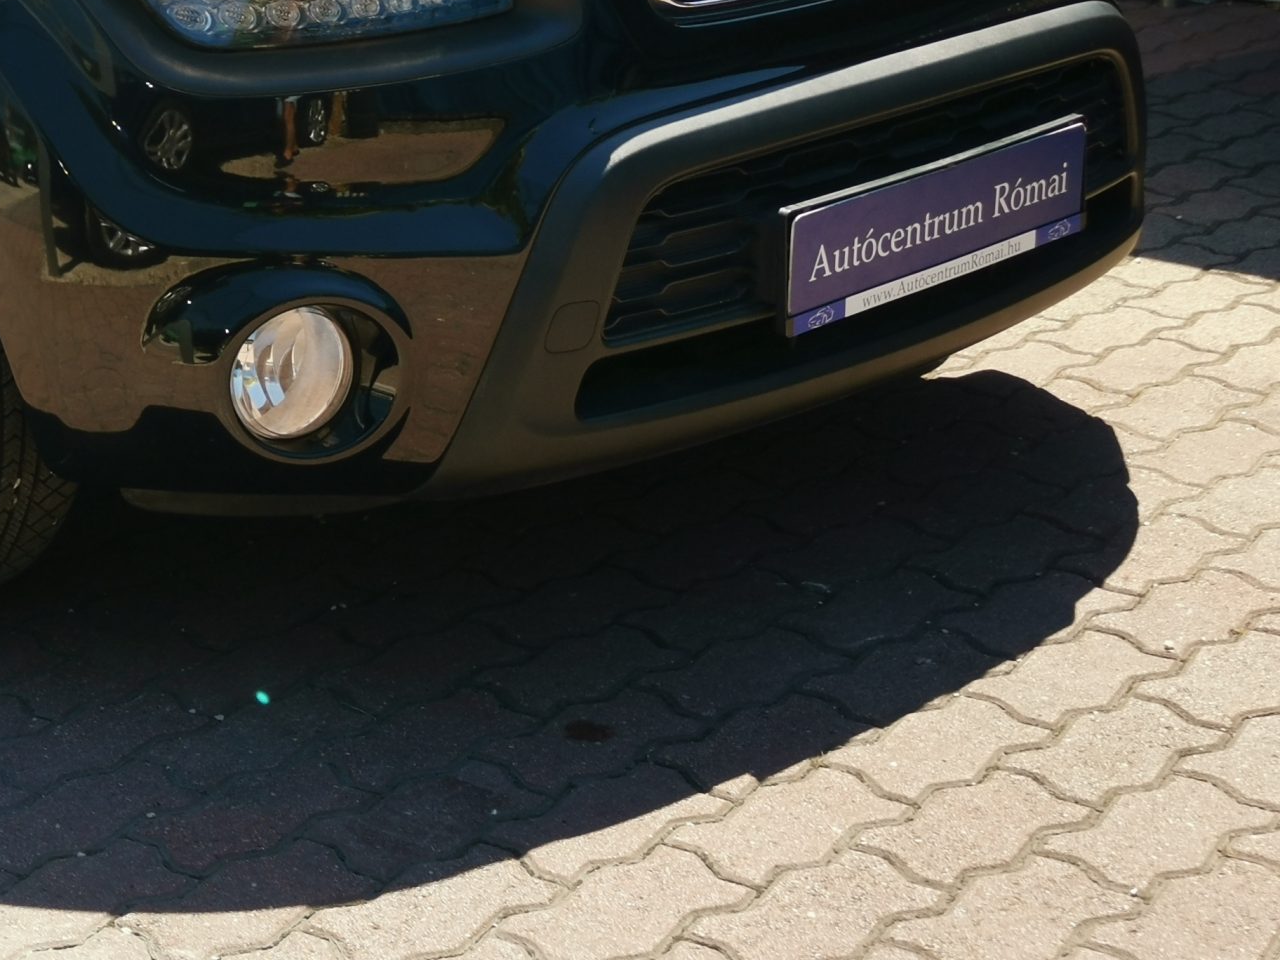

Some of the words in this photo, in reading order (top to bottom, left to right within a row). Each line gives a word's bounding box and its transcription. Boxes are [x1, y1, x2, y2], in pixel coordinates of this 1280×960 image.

[808, 201, 984, 283] Autócentrum
[991, 161, 1070, 219] Római
[862, 240, 1022, 308] www.AutócentrumRómai.hu
